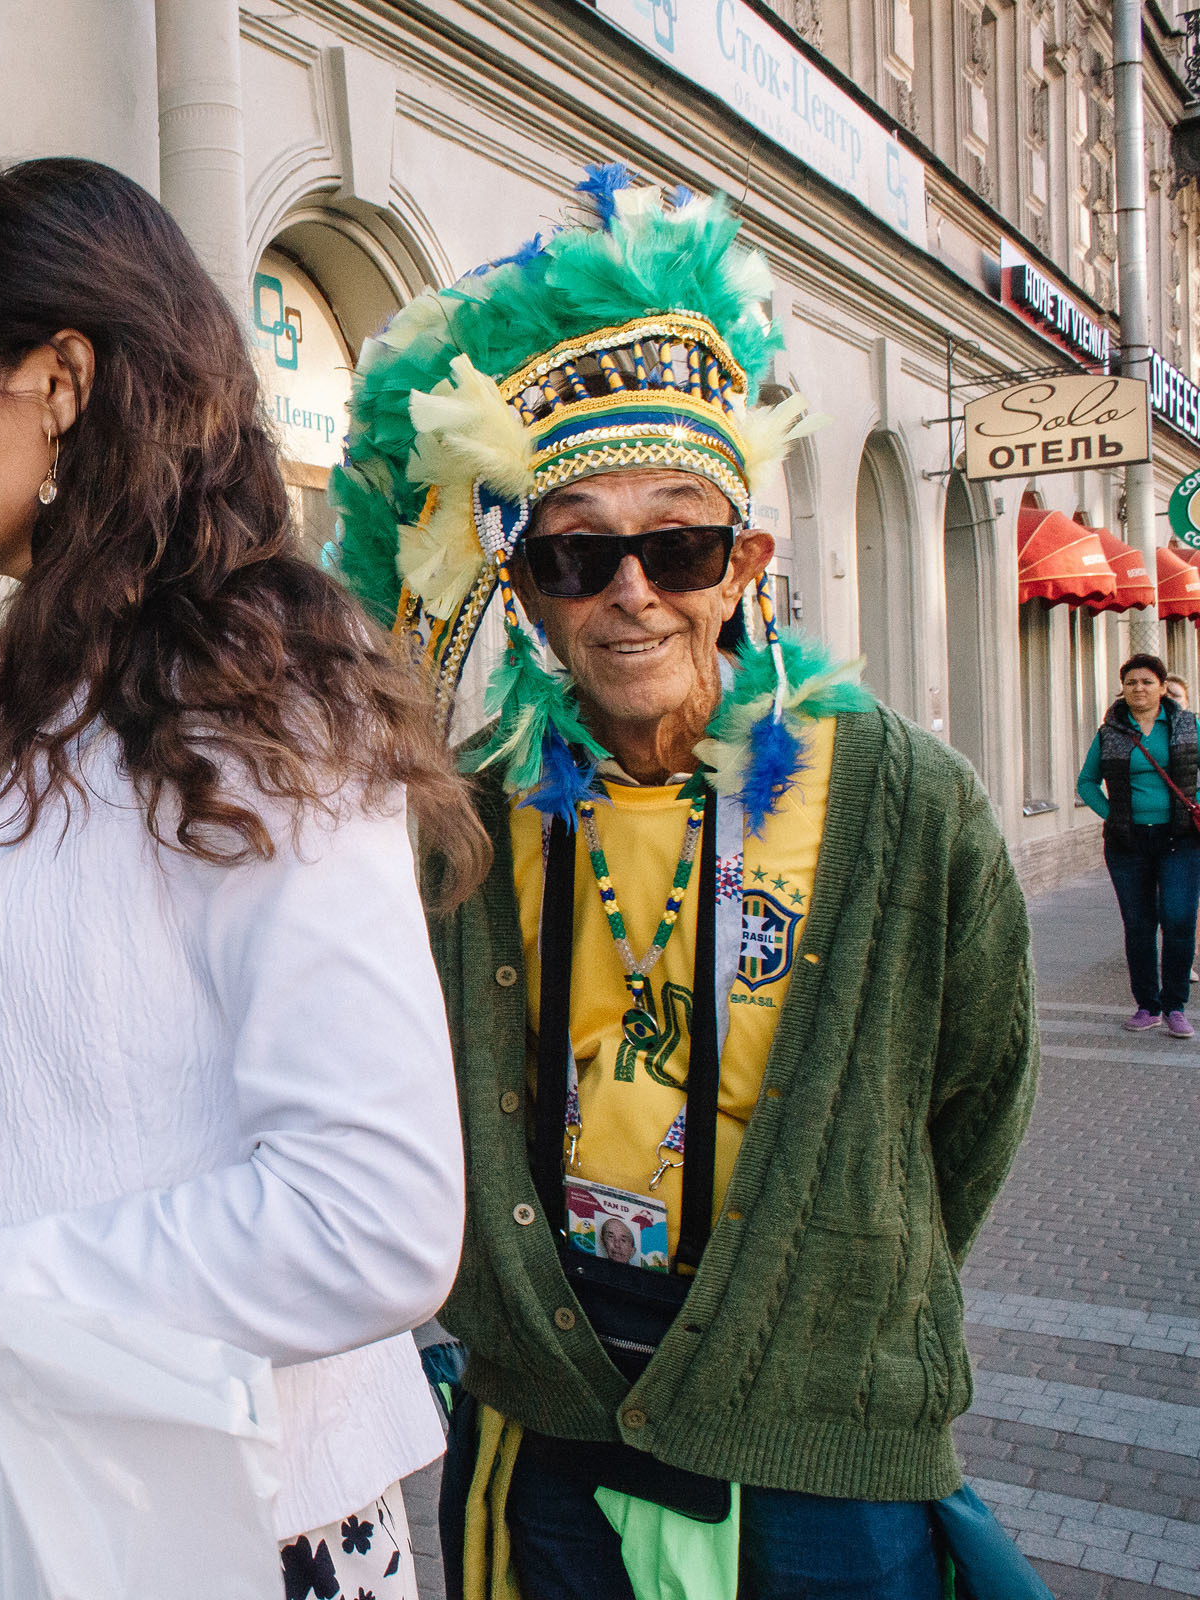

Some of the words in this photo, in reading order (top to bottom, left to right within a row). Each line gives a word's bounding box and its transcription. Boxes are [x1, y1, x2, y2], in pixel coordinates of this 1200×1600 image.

[715, 0, 862, 181] Сток-Центр
[1024, 263, 1055, 323] HOME
[1056, 294, 1071, 335] IN
[1071, 307, 1110, 361] VIENNA
[268, 394, 336, 444] -Центр
[974, 379, 1137, 438] Solo
[988, 433, 1125, 470] ОТЕЛЬ
[742, 930, 774, 944] RASIL
[730, 993, 777, 1008] BRASIL
[603, 1200, 620, 1211] FAN
[620, 1205, 630, 1213] ID
